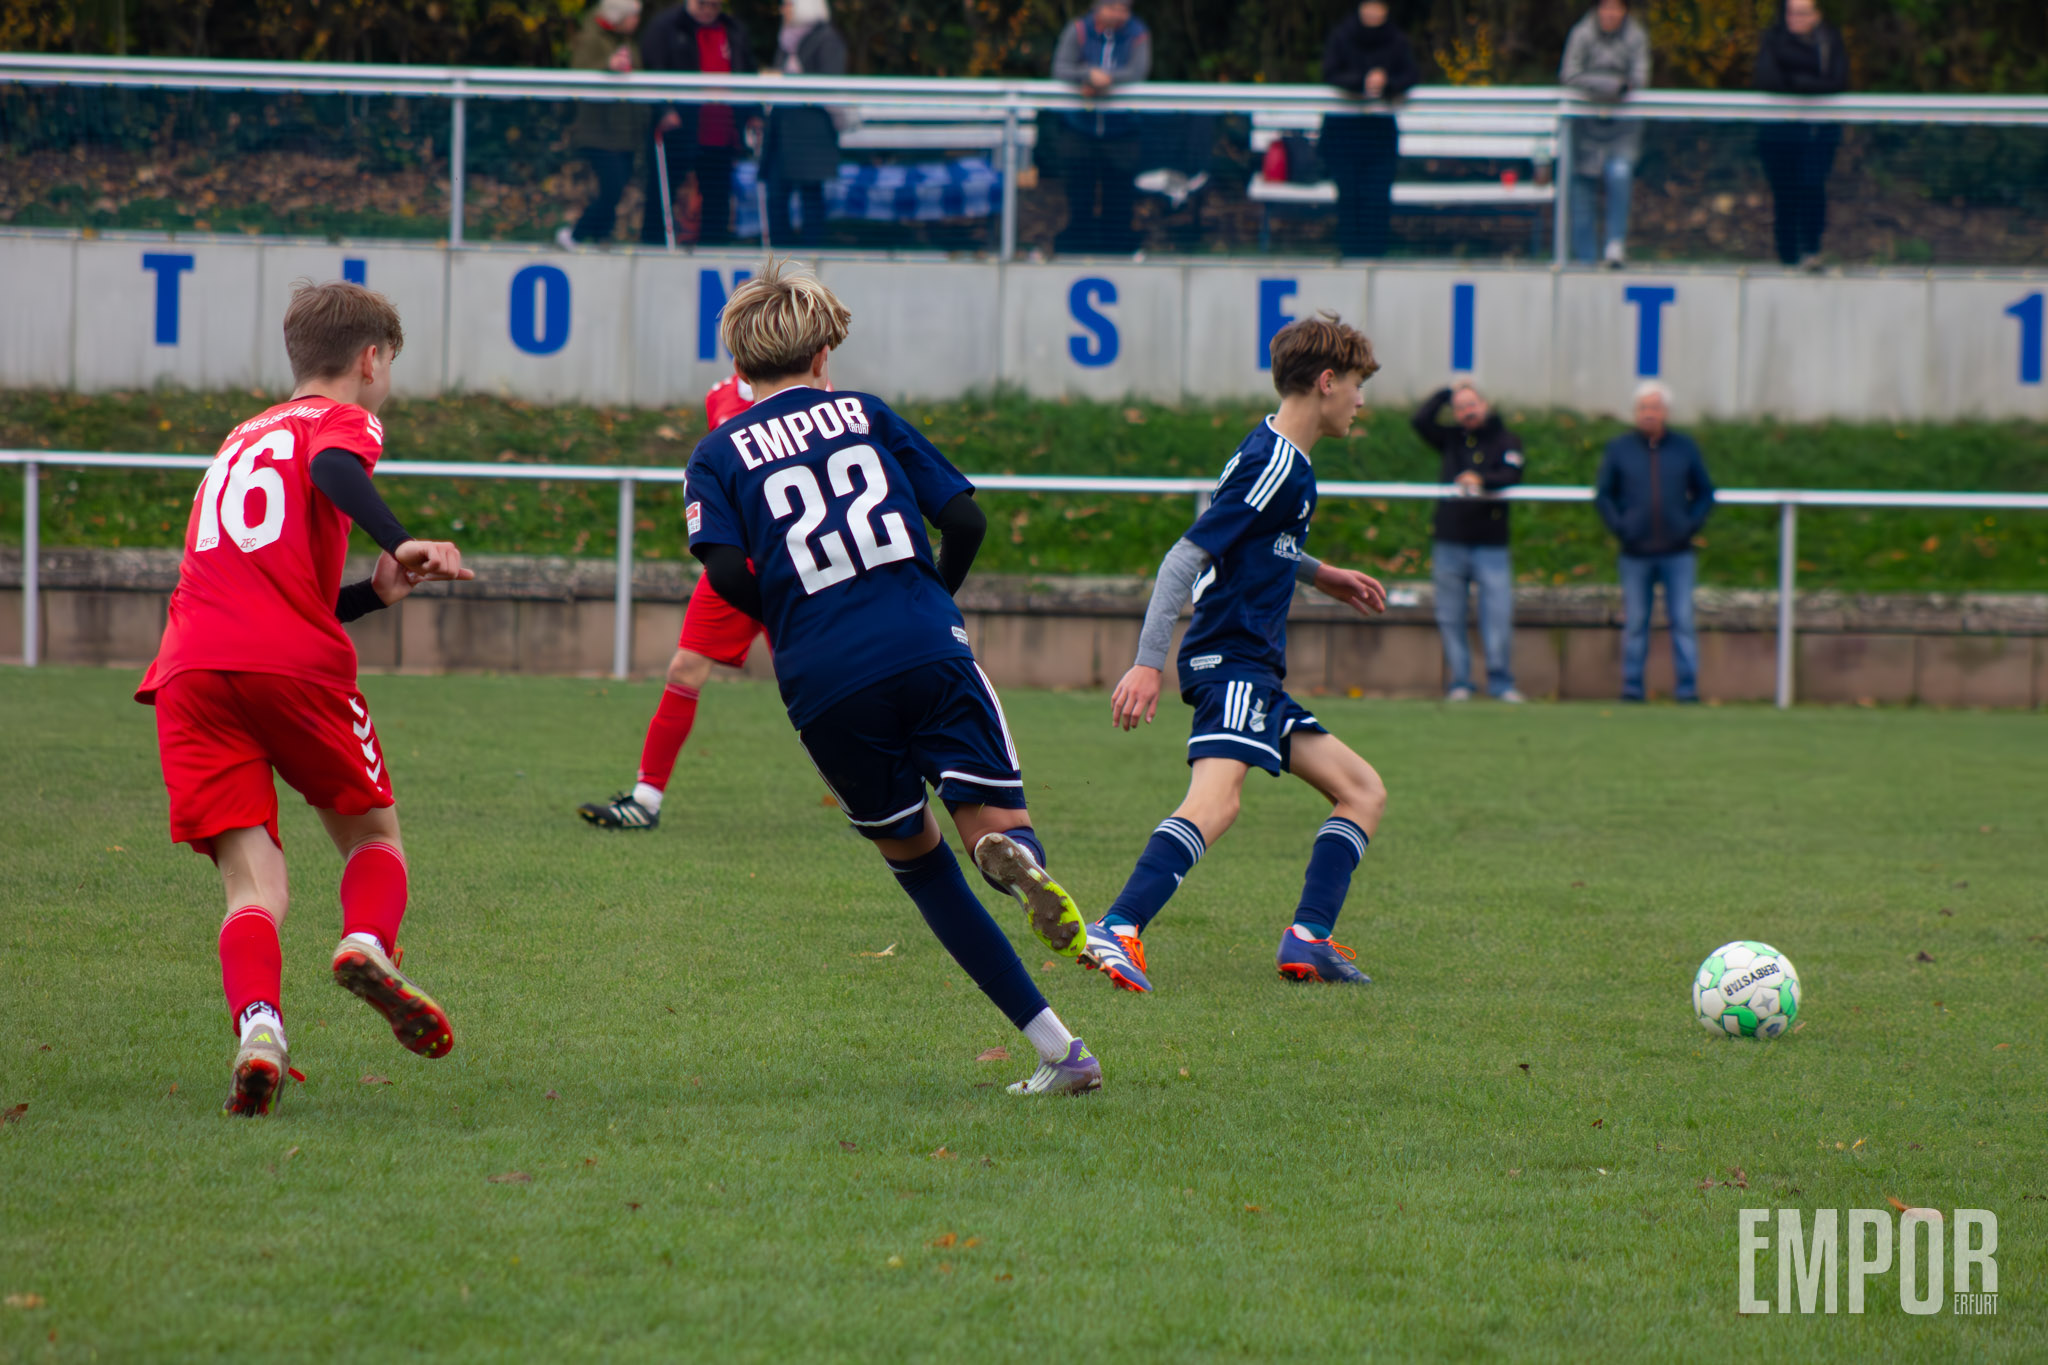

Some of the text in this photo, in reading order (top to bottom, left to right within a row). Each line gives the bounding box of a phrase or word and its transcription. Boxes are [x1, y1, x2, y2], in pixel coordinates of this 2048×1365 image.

[730, 397, 868, 471] EMPOR
[194, 429, 295, 553] 16
[199, 536, 217, 548] ZFC
[240, 537, 257, 549] ZFC
[763, 444, 915, 596] 22
[1723, 962, 1781, 997] DERBYSTAR
